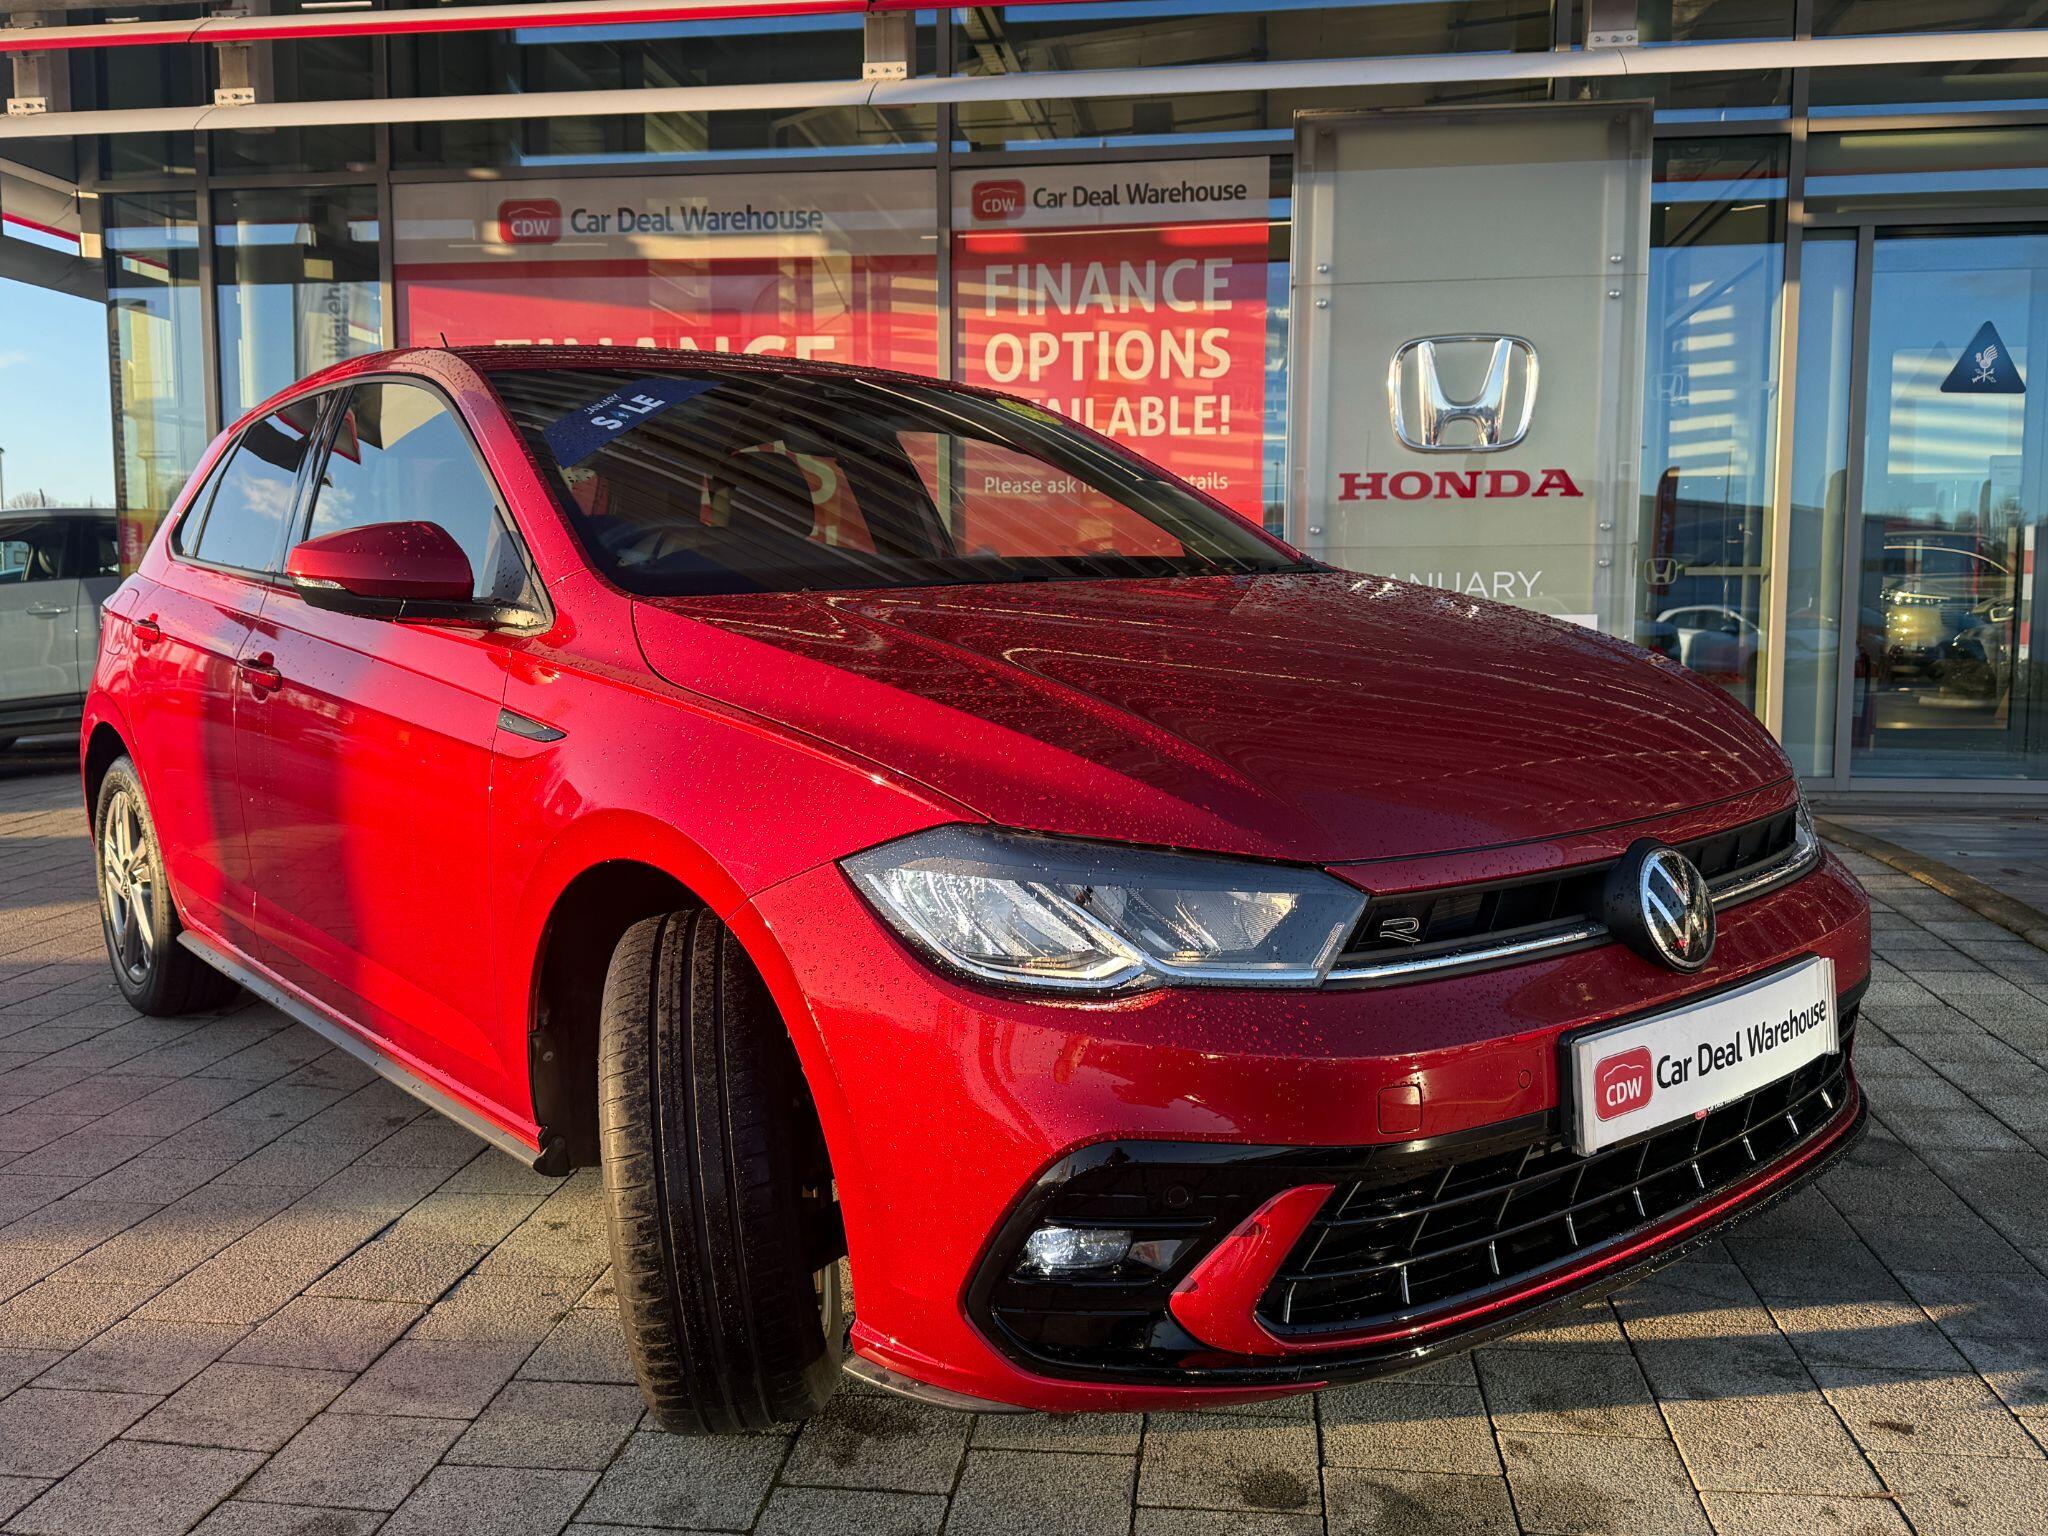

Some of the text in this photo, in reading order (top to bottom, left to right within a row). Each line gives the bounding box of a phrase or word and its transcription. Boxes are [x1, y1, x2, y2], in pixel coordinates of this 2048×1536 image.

[982, 198, 1016, 214] CDW
[1033, 181, 1247, 209] Car Deal Warehouse
[510, 217, 550, 238] CDW
[570, 204, 824, 234] Car Deal Warehouse
[984, 258, 1233, 317] FINANCE
[984, 327, 1231, 383] OPTIONS
[1031, 394, 1231, 437] ILABLE!
[984, 476, 1042, 494] Please
[1047, 475, 1077, 494] ask
[1181, 471, 1229, 490] tails
[1338, 469, 1584, 501] HONDA
[1656, 999, 1827, 1089] Car Deal Warehouse
[1606, 1075, 1643, 1107] CDW
